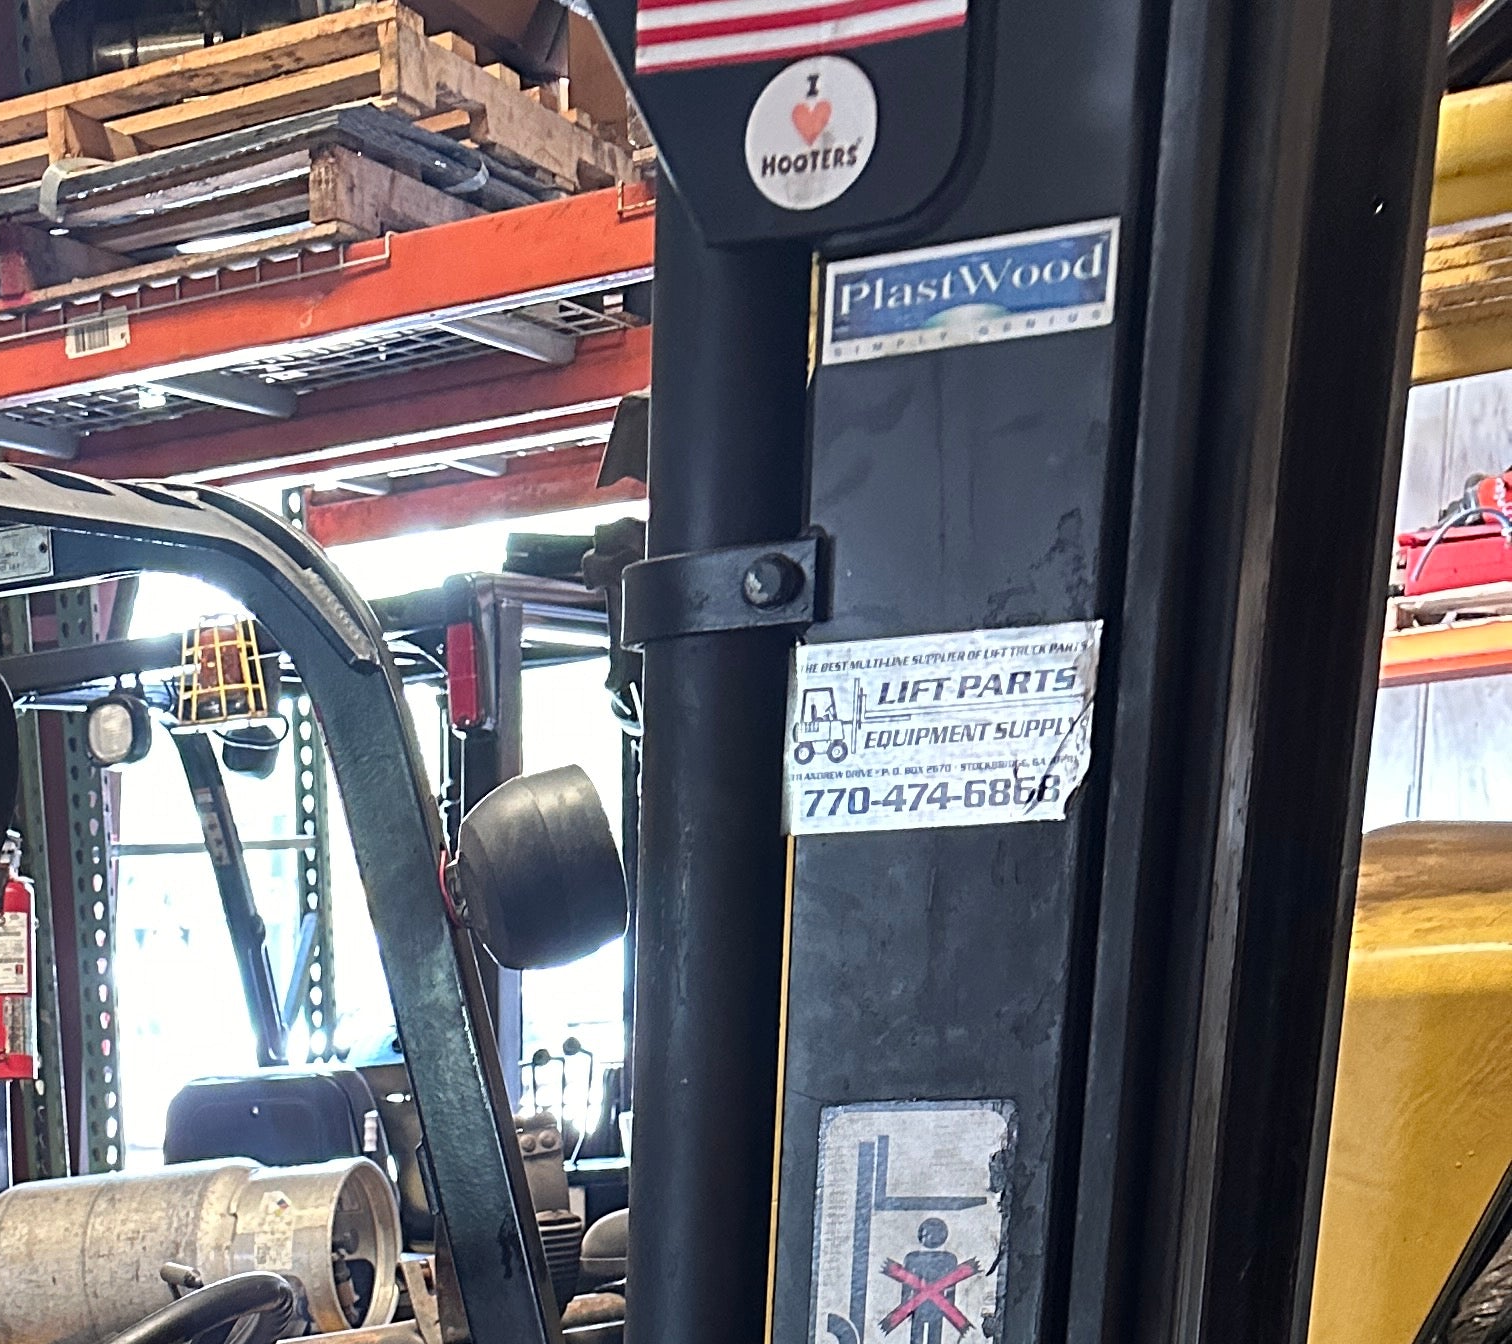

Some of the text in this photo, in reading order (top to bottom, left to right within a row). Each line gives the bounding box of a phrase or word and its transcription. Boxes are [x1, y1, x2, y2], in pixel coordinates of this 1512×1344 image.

[805, 73, 820, 97] I
[761, 144, 859, 177] HOOTERS
[840, 242, 1104, 315] PlastWood
[821, 662, 847, 673] BEST
[850, 656, 910, 671] MULTI-LINE
[912, 650, 965, 666] SUPPLIER
[967, 650, 982, 661] OF
[1011, 644, 1046, 657] TRUCK
[878, 666, 1078, 705] LIFT PARTS
[864, 716, 1075, 750] EQUIPMENT SUPPLY
[804, 774, 1061, 818] 770-474-6868
